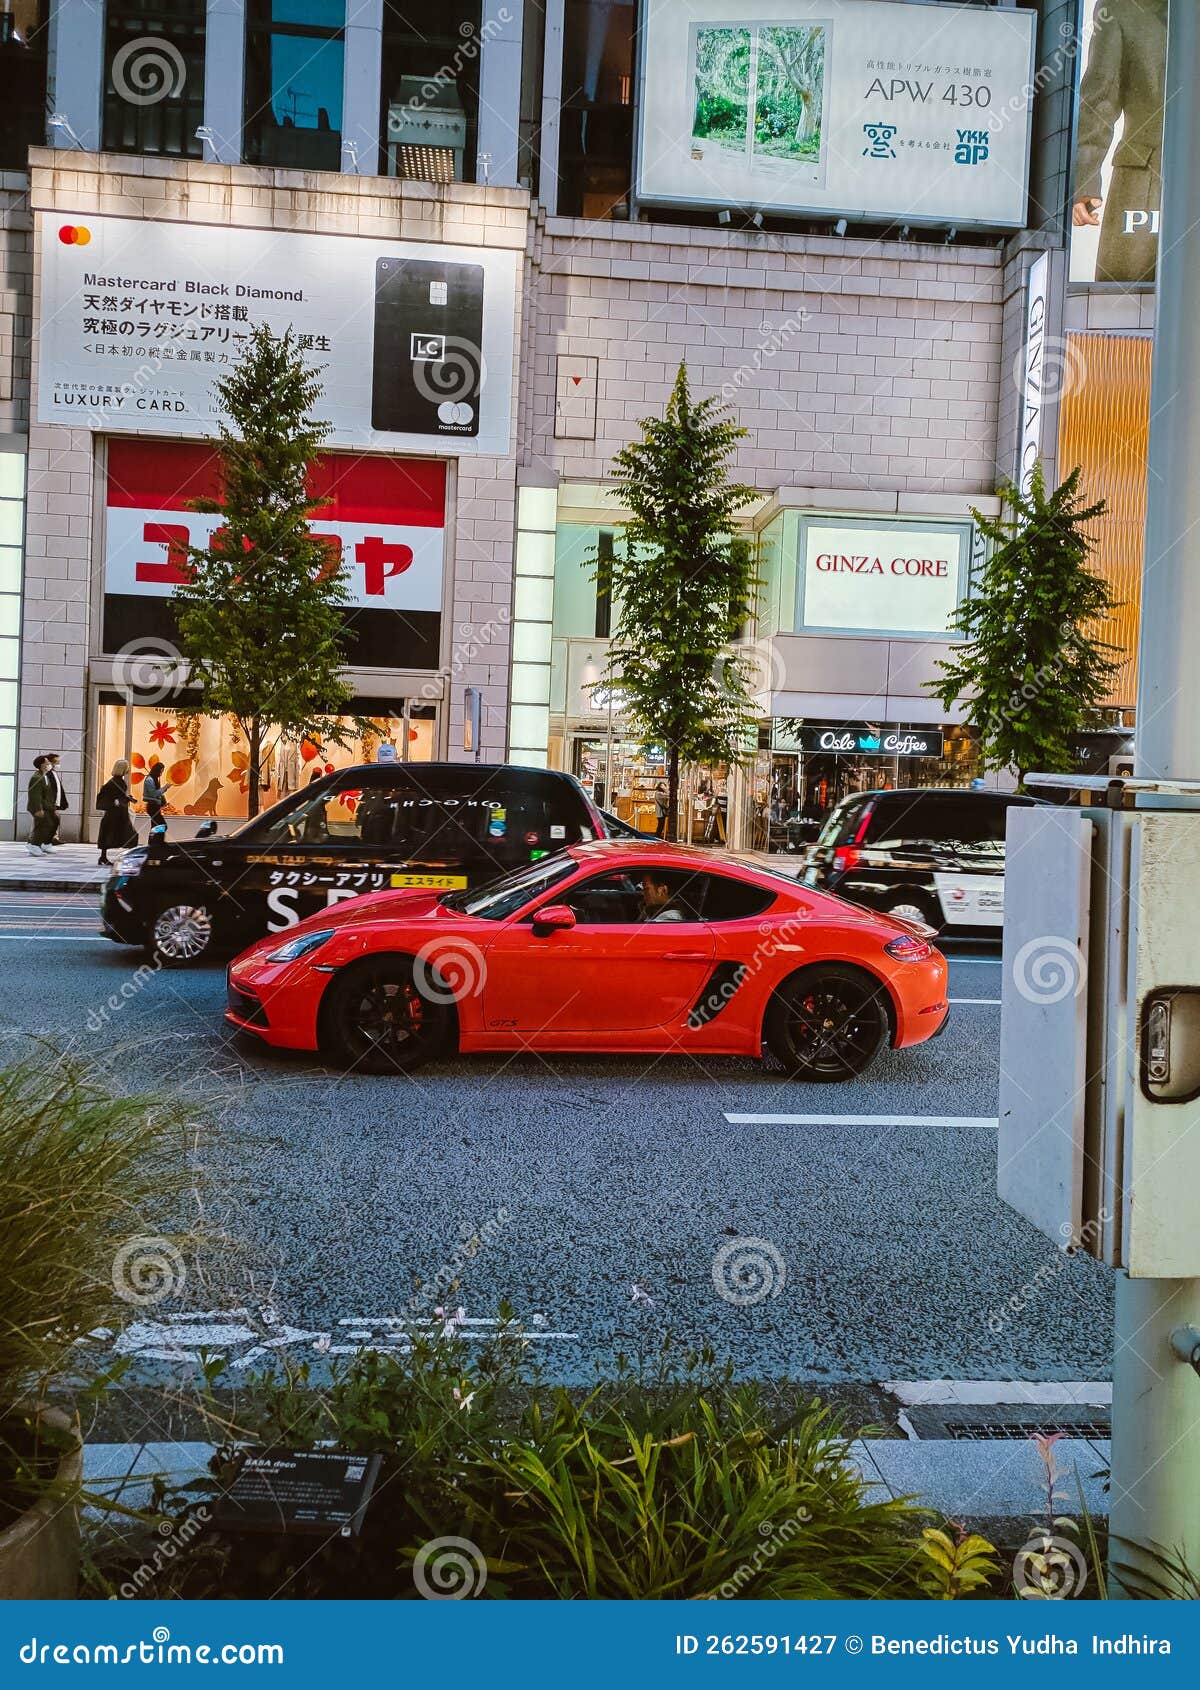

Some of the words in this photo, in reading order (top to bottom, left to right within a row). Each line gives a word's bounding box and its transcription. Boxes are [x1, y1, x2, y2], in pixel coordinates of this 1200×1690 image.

[864, 78, 934, 103] APW
[942, 84, 992, 108] 430
[956, 129, 989, 145] YKK
[184, 280, 229, 297] Black
[83, 294, 249, 322] 天然ダイヤモンド搭載
[417, 340, 438, 355] LC
[1025, 295, 1044, 431] GINZA
[54, 393, 125, 408] LUXURY
[208, 404, 226, 413] lux
[438, 424, 473, 432] mastercard
[816, 554, 884, 574] GINZA
[890, 558, 948, 577] CORE
[820, 731, 856, 750] Oslo
[883, 735, 928, 754] Coffee
[269, 871, 384, 887] タクシーアプリ
[404, 877, 455, 886] エスライド
[489, 1019, 519, 1027] GTS
